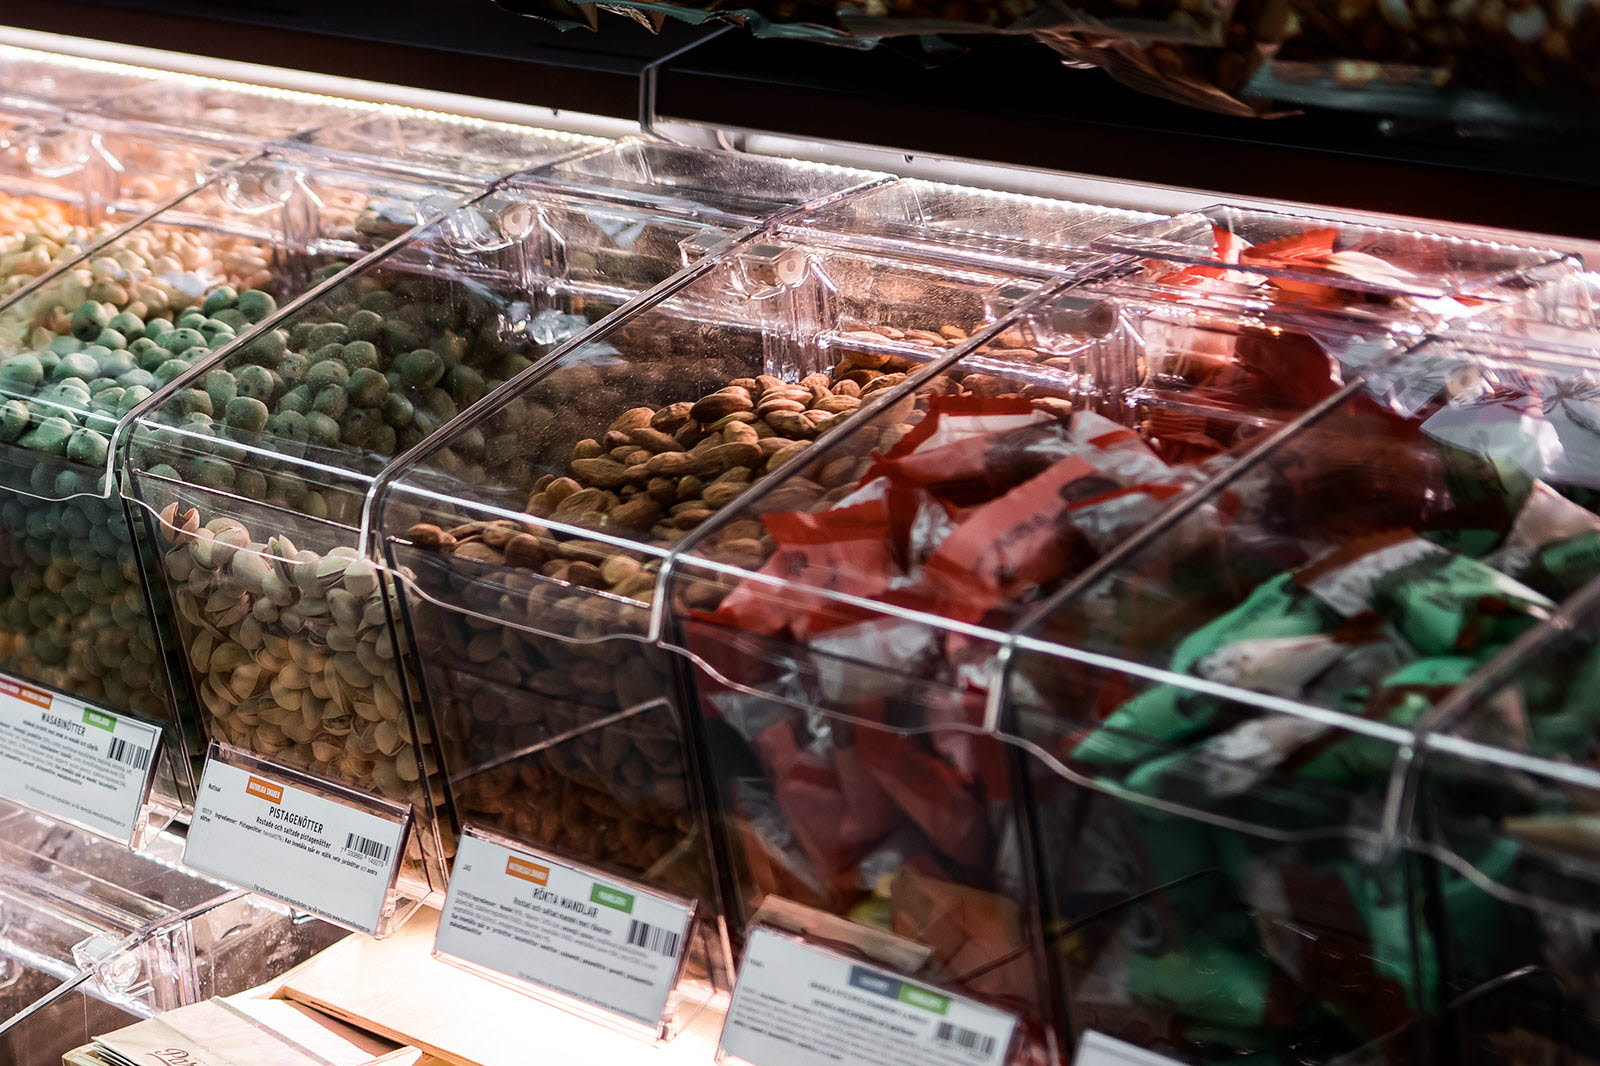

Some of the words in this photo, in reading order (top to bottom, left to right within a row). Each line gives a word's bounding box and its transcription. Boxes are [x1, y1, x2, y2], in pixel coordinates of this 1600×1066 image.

[41, 713, 86, 736] WASABINÖTTER
[256, 816, 274, 828] Rostade
[283, 827, 300, 838] saltade
[300, 833, 331, 848] pistagenötter
[269, 806, 323, 833] PISTAGENÖTTER
[533, 888, 558, 904] RÖKTA
[561, 898, 597, 917] MANDLAR
